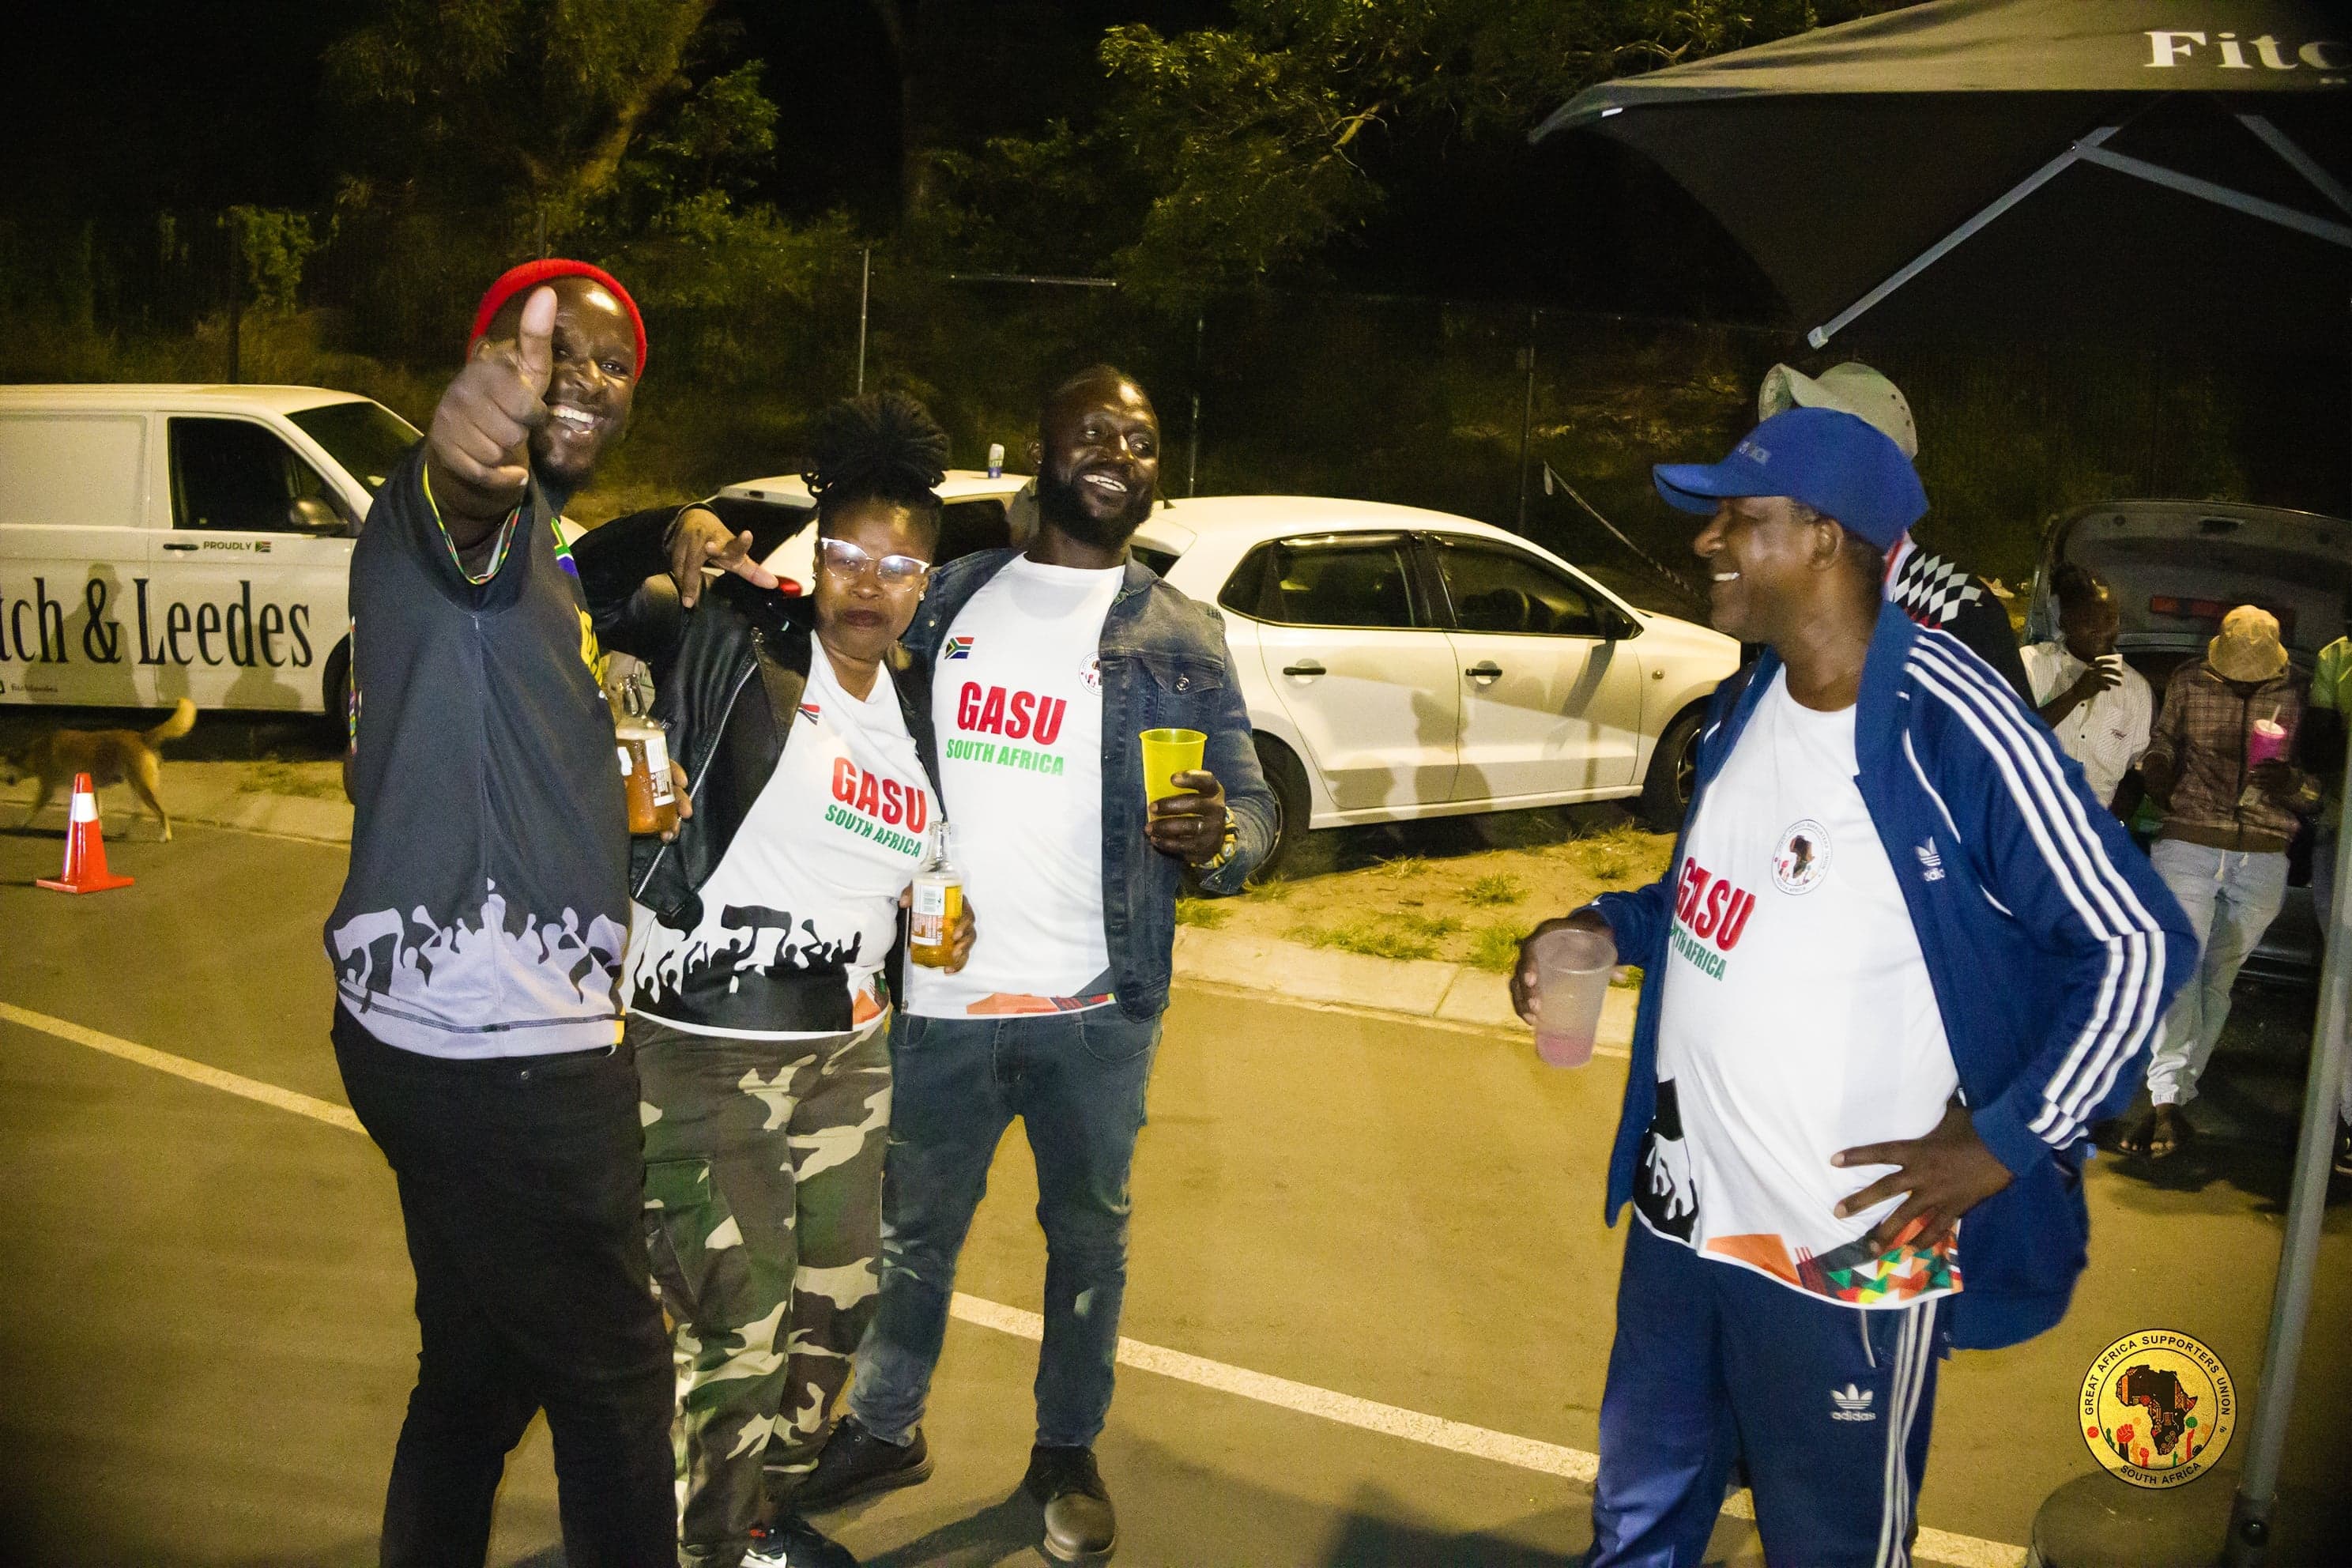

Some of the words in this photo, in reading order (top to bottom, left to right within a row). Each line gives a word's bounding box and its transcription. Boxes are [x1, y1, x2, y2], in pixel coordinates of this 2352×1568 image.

[203, 541, 252, 550] PROUDLY
[83, 578, 122, 664] &
[133, 578, 313, 668] Leedes
[957, 681, 1067, 745] GASU
[946, 738, 996, 763] SOUTH
[997, 745, 1064, 776] AFRICA
[832, 756, 927, 834] GASU
[824, 804, 873, 838] SOUTH
[873, 827, 922, 858] AFRICA
[1675, 856, 1757, 952] GASU
[1684, 938, 1728, 982] AFRICA
